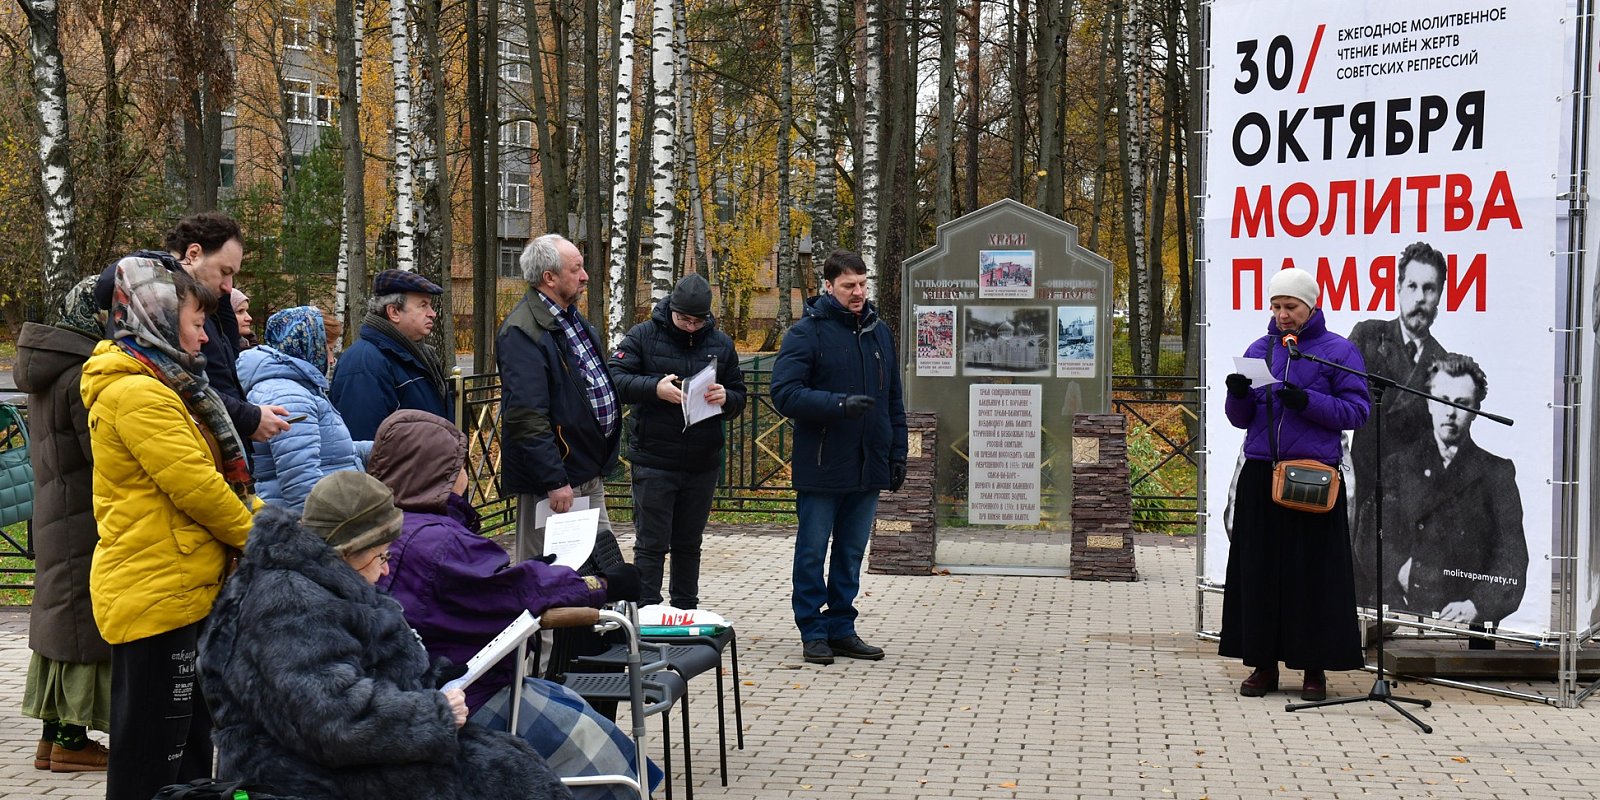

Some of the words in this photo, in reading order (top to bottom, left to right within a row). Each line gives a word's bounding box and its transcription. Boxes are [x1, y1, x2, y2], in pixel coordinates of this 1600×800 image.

[1338, 21, 1407, 42] ЕЖЕГОДНОЕ
[1410, 7, 1506, 32] МОЛИТВЕННОЕ
[1336, 61, 1403, 80] СОВЕТСКИХ
[1407, 50, 1478, 73] РЕПРЕССИЙ
[1337, 45, 1378, 61] ЧТЕНИЕ
[1382, 38, 1417, 56] ИМЁН
[1420, 34, 1459, 52] ЖЕРТВ
[1232, 90, 1486, 167] ОКТЯБРЯ
[1230, 170, 1523, 239] МОЛИТВА
[1231, 253, 1487, 312] ПМЯИ
[1443, 568, 1518, 586] molitvapamyaty.ru
